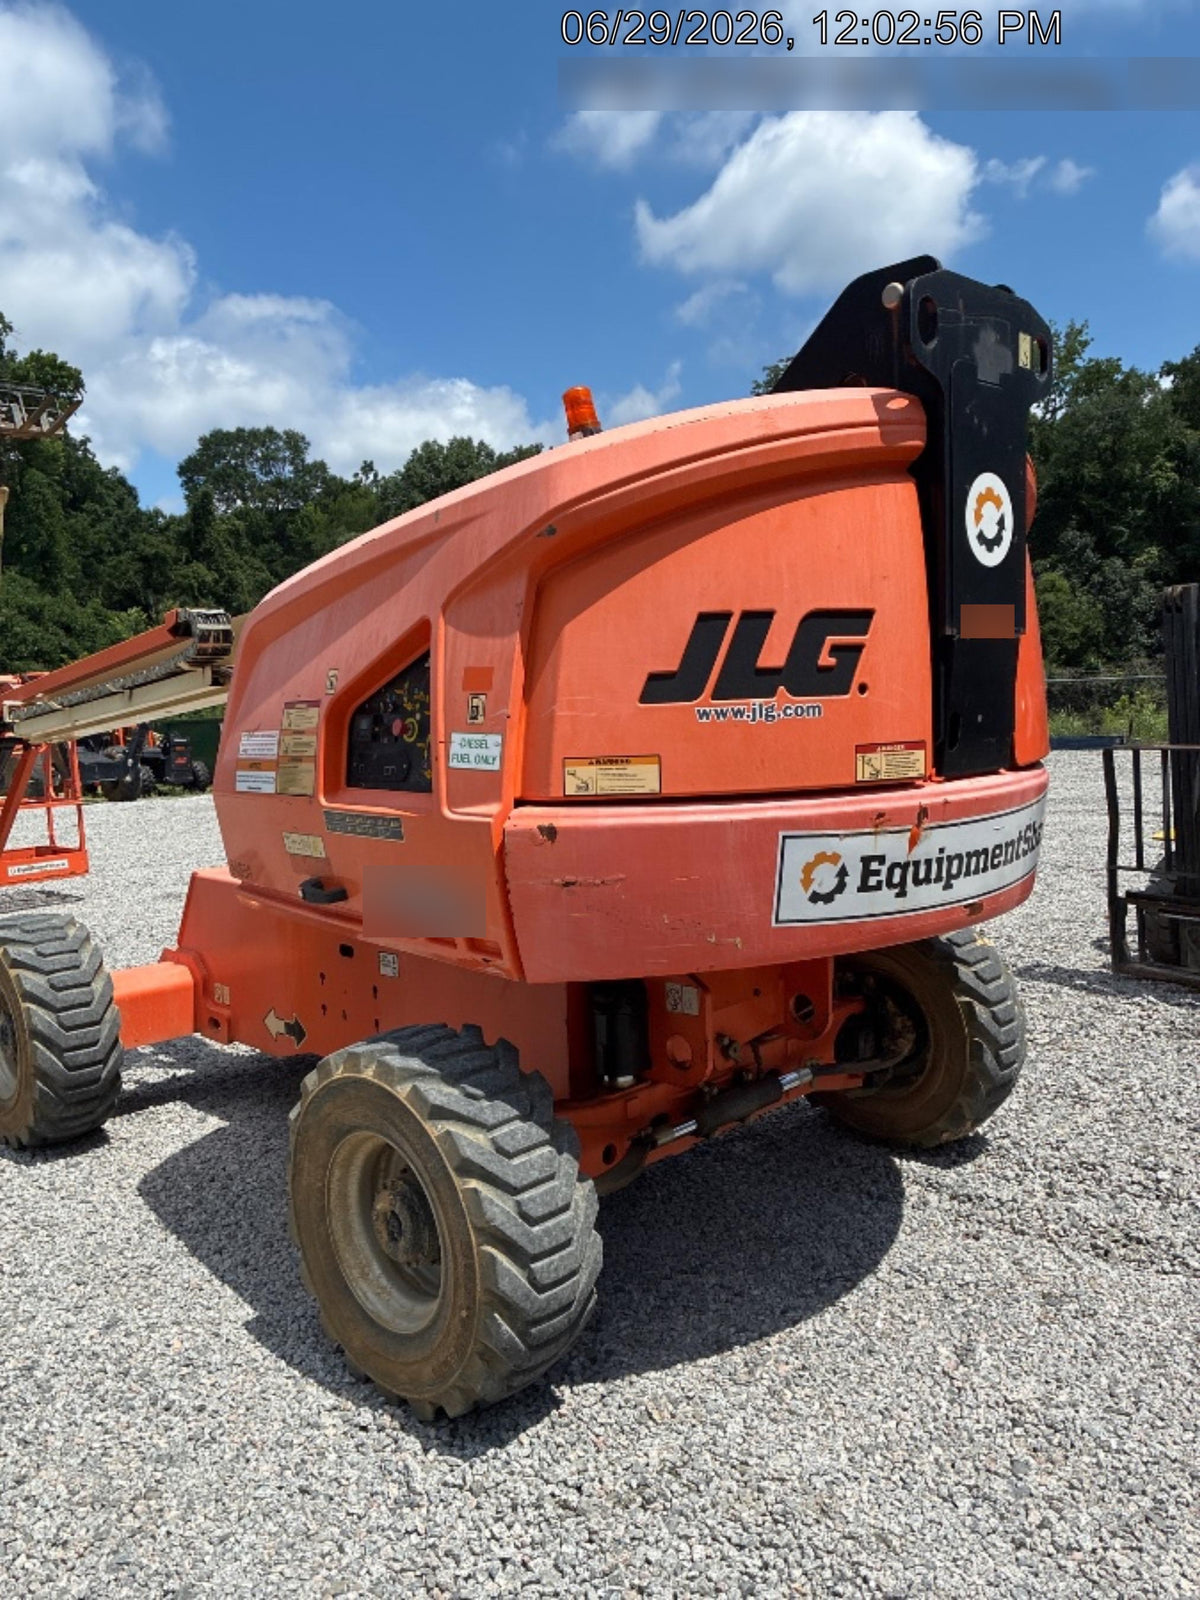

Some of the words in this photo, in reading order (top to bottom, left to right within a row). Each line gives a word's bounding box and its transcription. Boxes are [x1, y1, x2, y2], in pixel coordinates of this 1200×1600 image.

[639, 609, 876, 704] JLG
[696, 702, 822, 722] www.jlg.com
[451, 753, 470, 764] FUEL
[474, 754, 498, 765] ONLY
